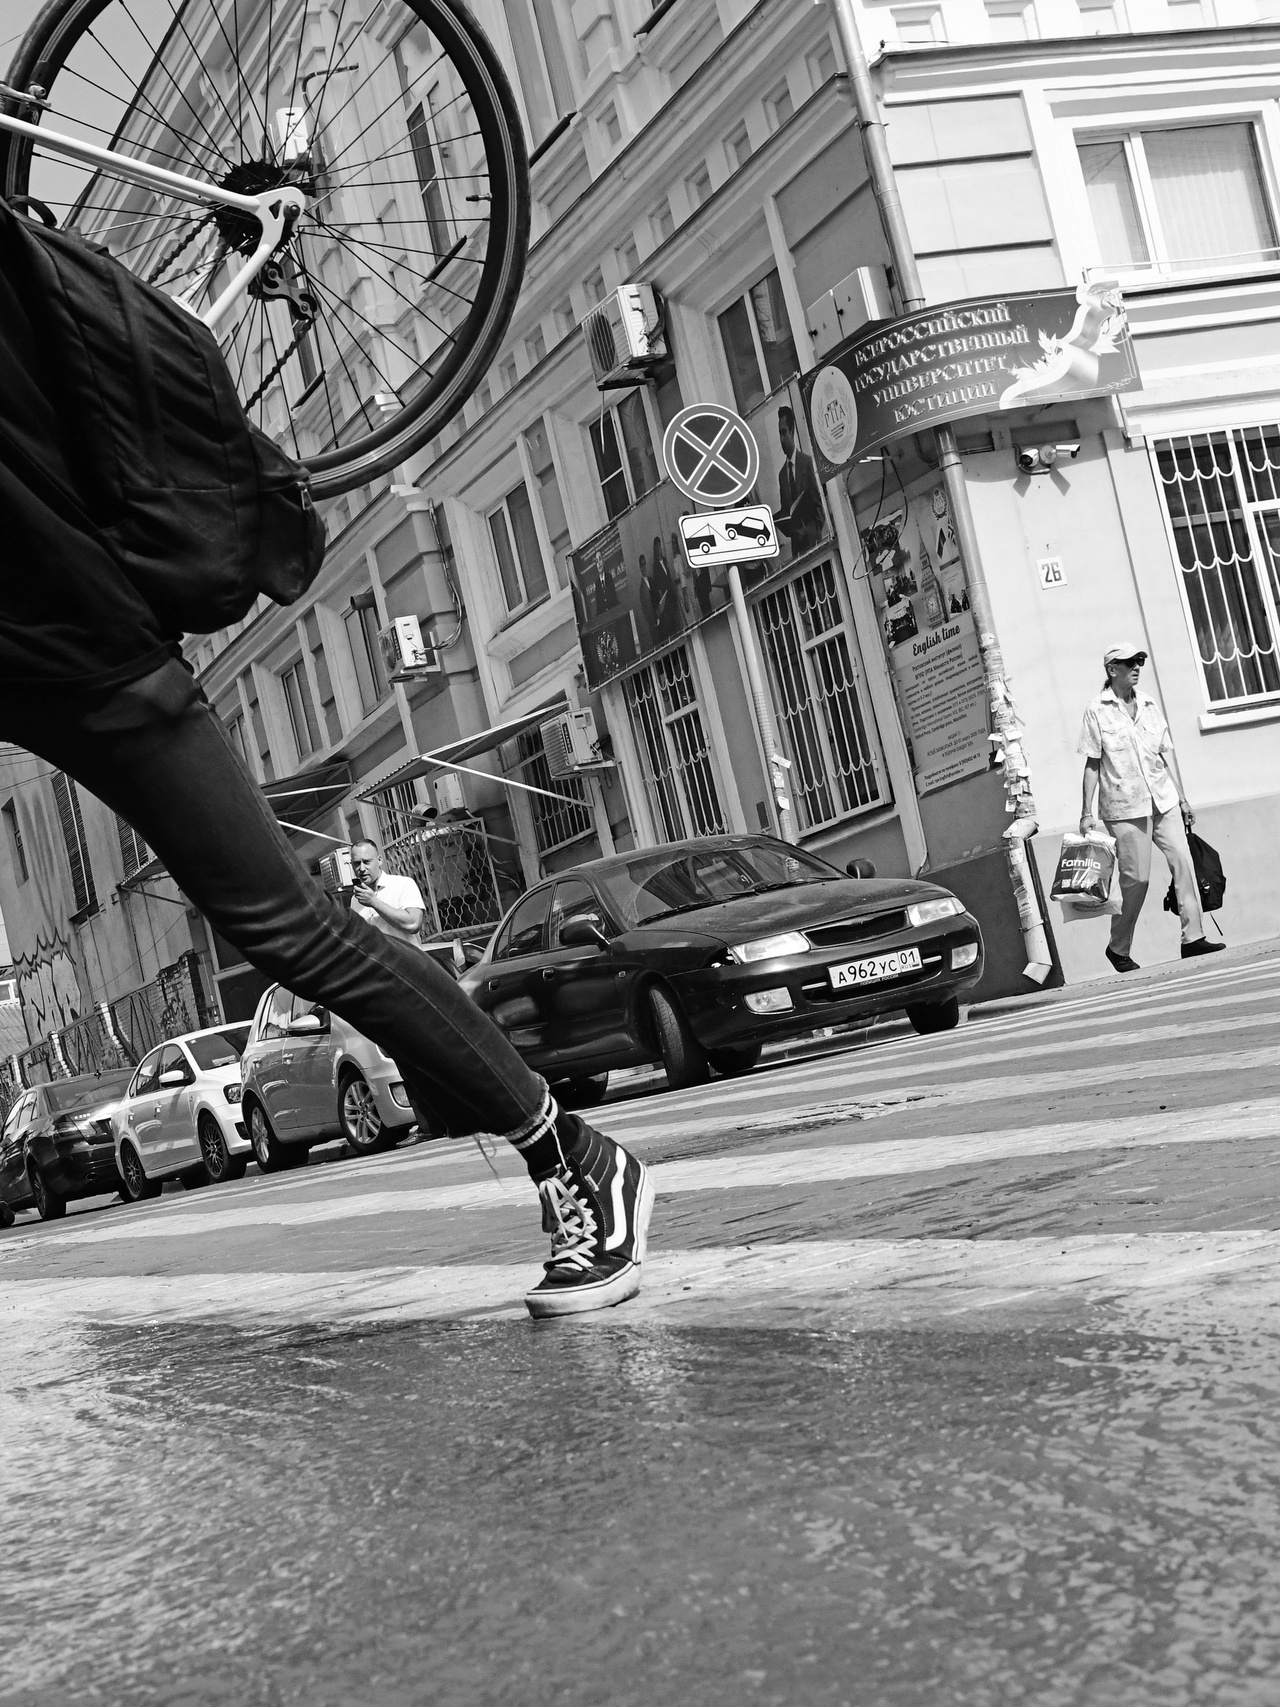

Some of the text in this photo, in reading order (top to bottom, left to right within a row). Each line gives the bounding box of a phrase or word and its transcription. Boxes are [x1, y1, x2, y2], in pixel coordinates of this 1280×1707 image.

[854, 303, 1012, 367] ВСЕРОССИЙСКИЙ
[854, 324, 1030, 393] ГОСУДАРСТВЕННЫЙ
[872, 353, 1008, 407] УНИВЕРСИТЕТ
[893, 380, 997, 424] ЮСТИЦИИ
[1041, 561, 1062, 582] 26
[912, 625, 961, 656] English time
[1061, 858, 1101, 870] familia
[838, 951, 916, 984] А962УС 01
